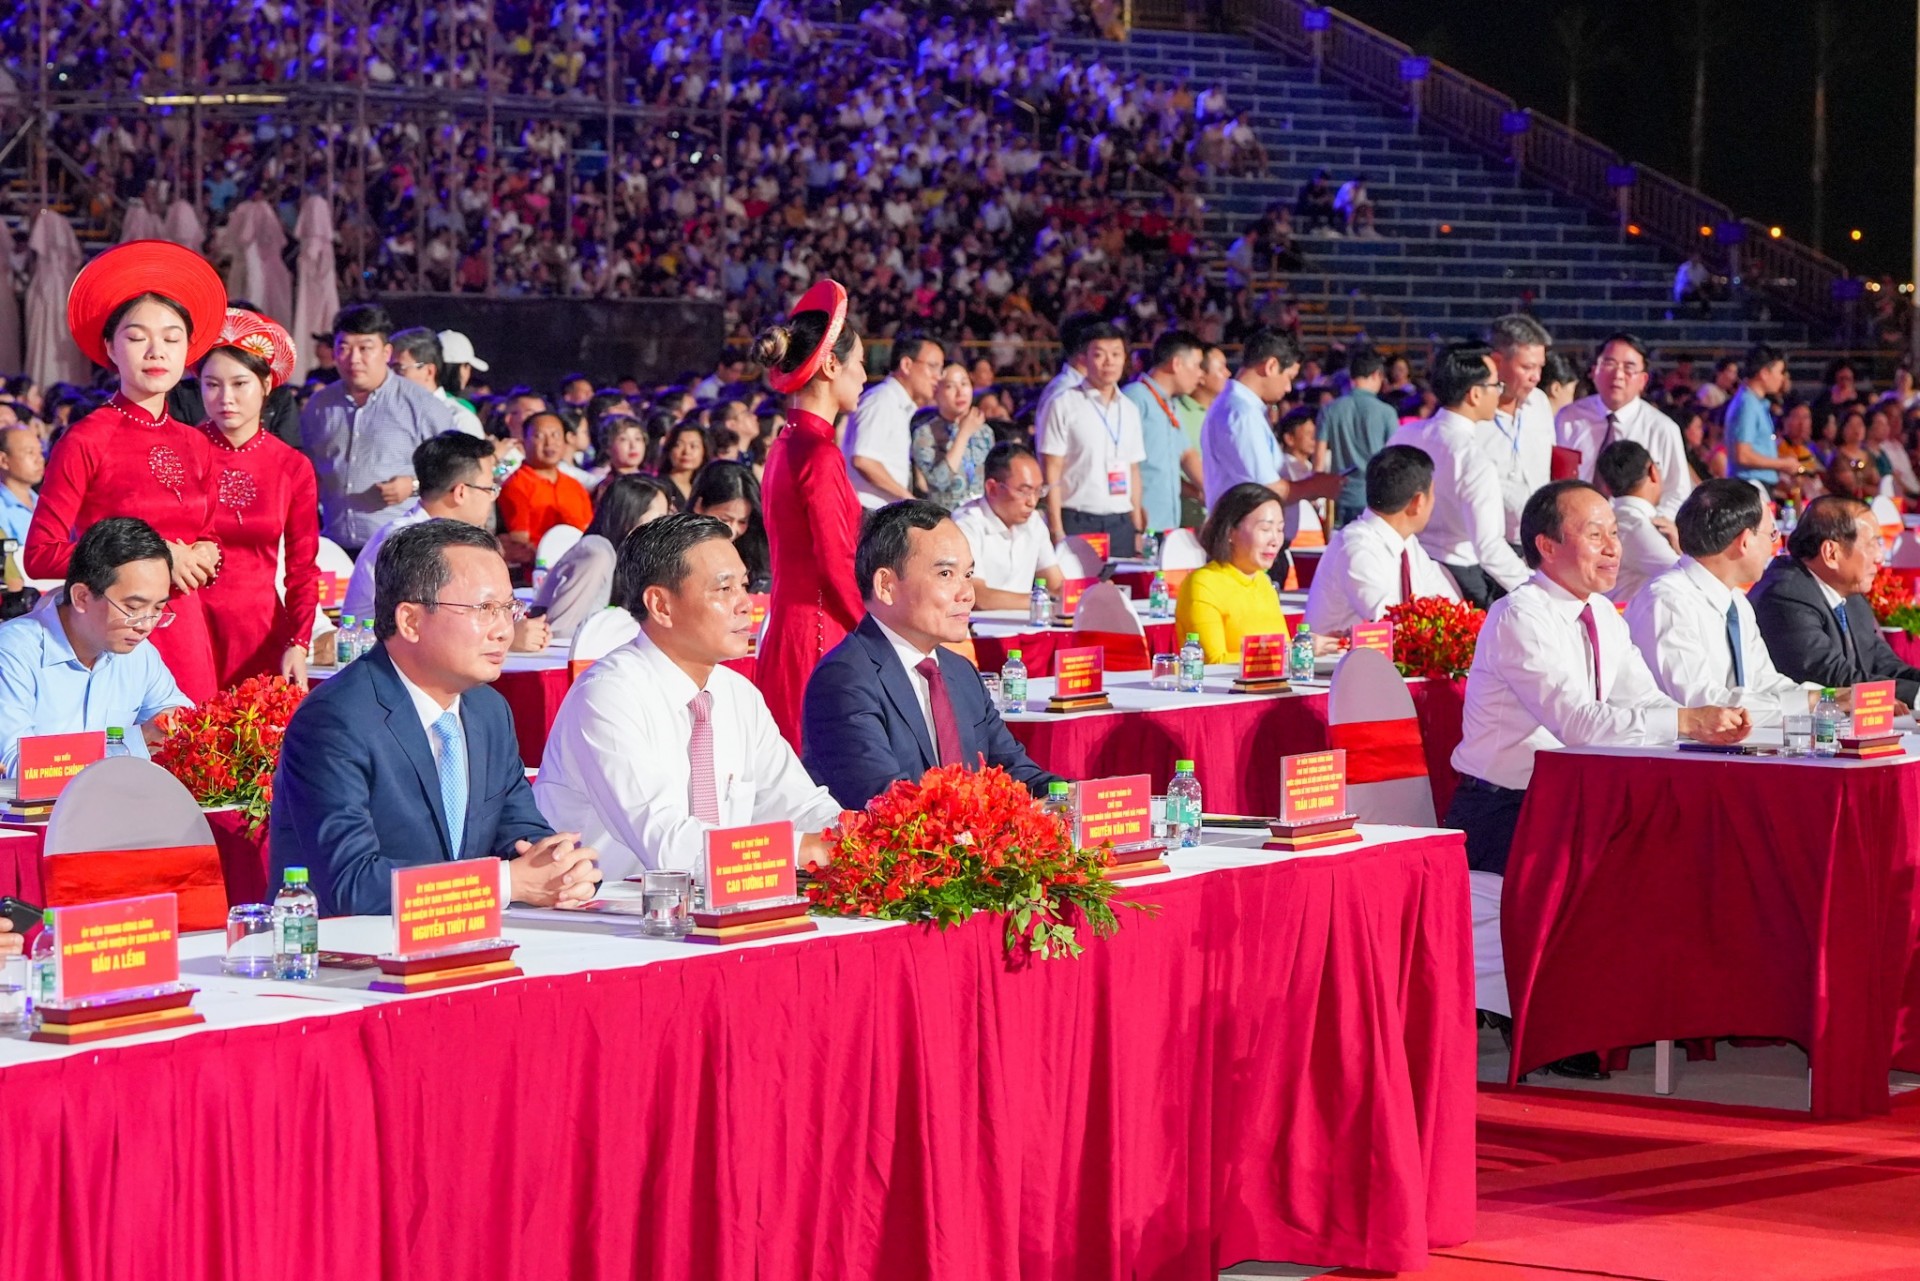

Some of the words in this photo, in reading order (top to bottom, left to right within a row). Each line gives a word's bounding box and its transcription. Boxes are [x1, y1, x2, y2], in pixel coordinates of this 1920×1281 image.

[24, 767, 39, 780] VĂN
[40, 765, 63, 779] PHÒNG
[726, 879, 741, 893] CAO
[468, 915, 486, 931] ANH
[112, 955, 121, 970] A
